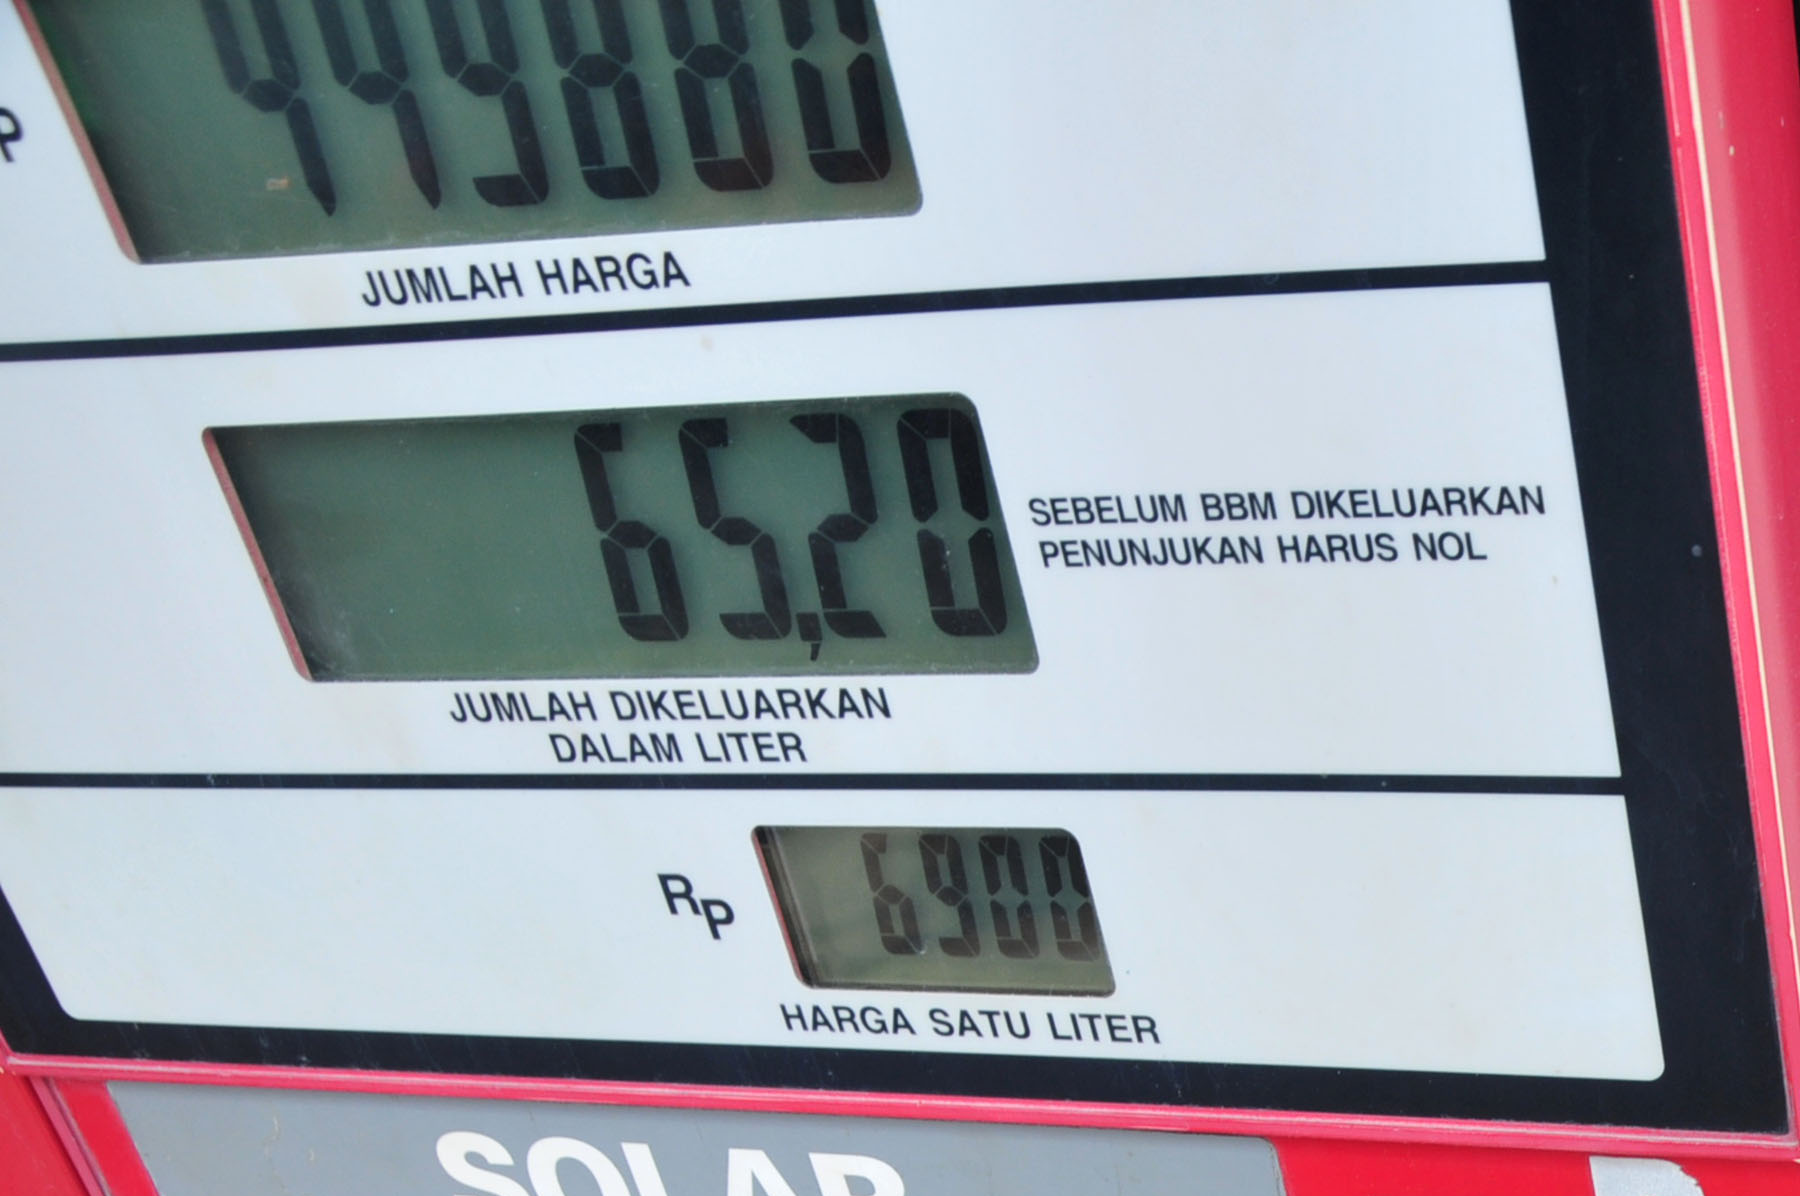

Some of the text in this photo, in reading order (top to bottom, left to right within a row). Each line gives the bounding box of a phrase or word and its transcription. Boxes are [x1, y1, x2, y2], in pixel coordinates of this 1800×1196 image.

[362, 251, 690, 308] JUMLAH HARGA
[1028, 485, 1547, 526] SEBELUM BBM DIKELUARKAN
[1038, 531, 1488, 568] PENUNJUKAN HARUS NOL
[450, 687, 893, 725] JUMLAH DIKELUARKAN
[549, 731, 807, 764] DALAM LITER
[859, 831, 1102, 962] 6900
[779, 1003, 1161, 1044] HARGA SATU LITER
